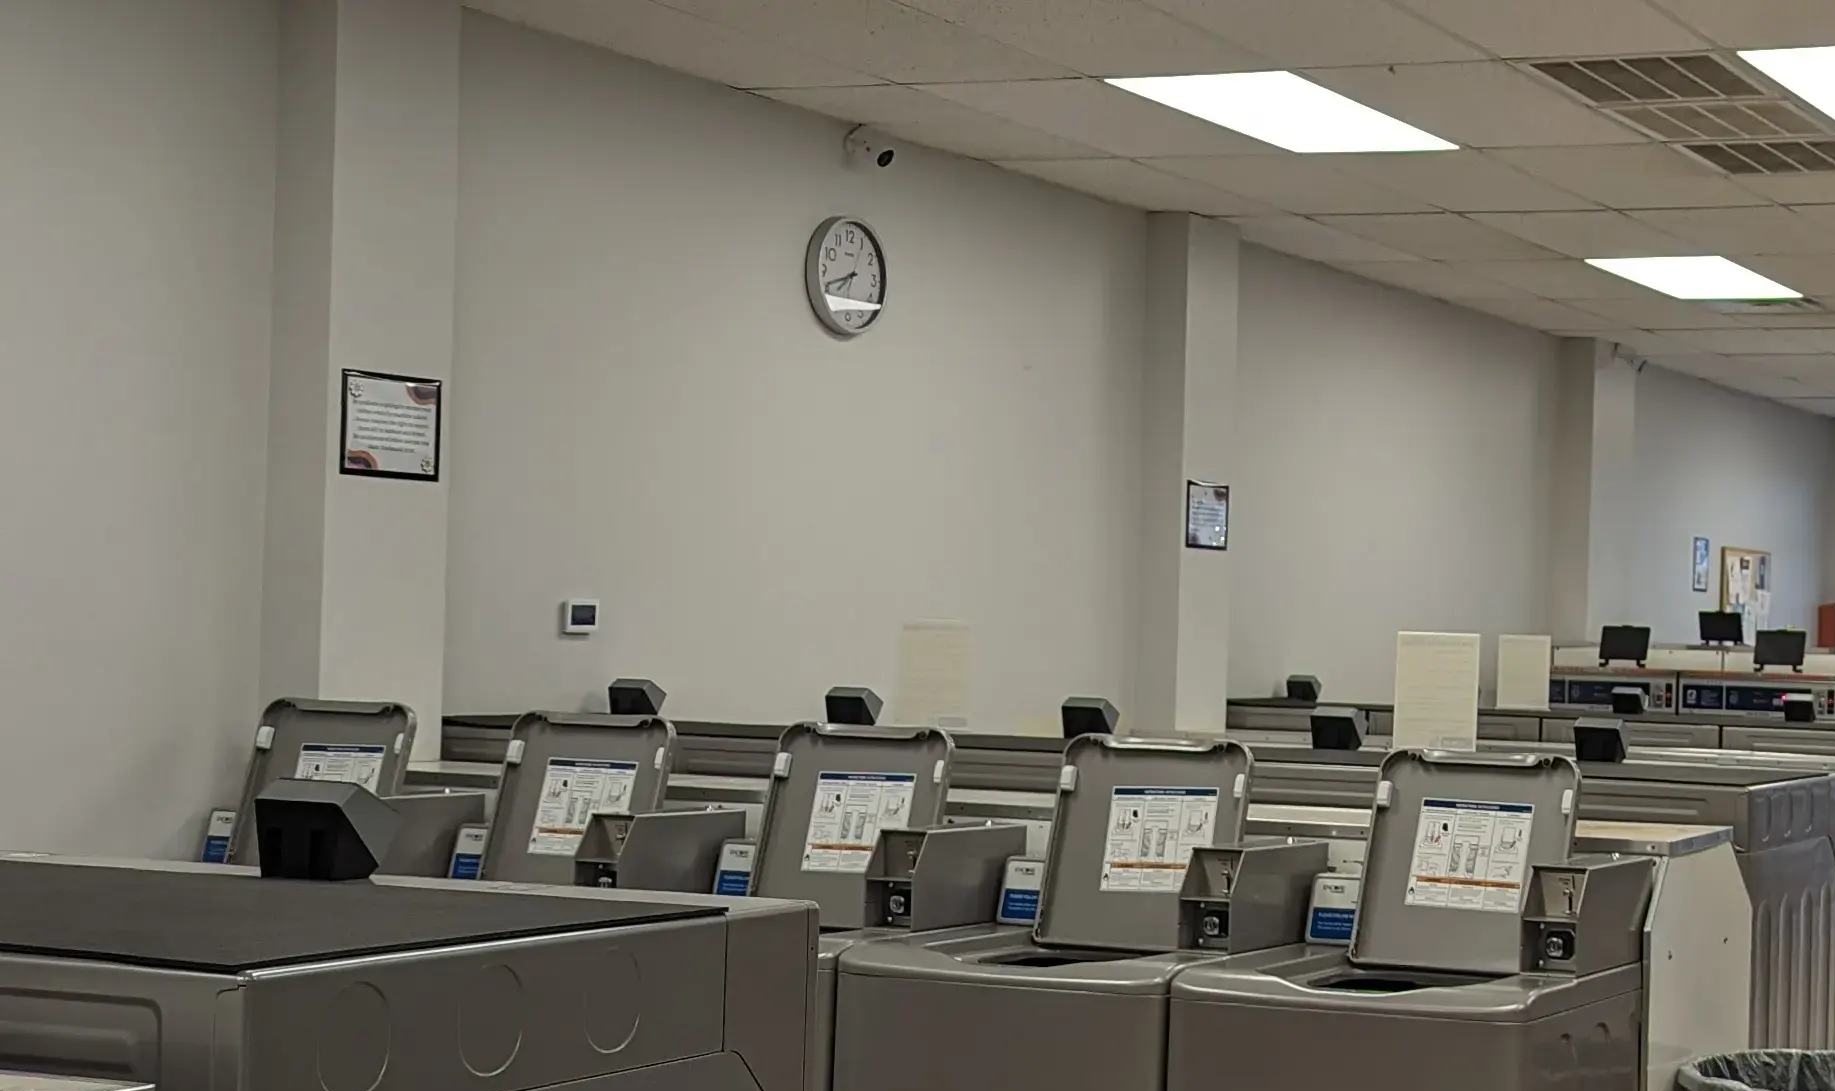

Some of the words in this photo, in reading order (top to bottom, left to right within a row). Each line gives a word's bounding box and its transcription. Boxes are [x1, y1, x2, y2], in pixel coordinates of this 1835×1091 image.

[834, 233, 842, 247] 11
[845, 229, 856, 244] 12
[860, 237, 864, 250] 1
[825, 246, 837, 262] 10
[867, 252, 874, 266] 2
[870, 273, 877, 288] 3
